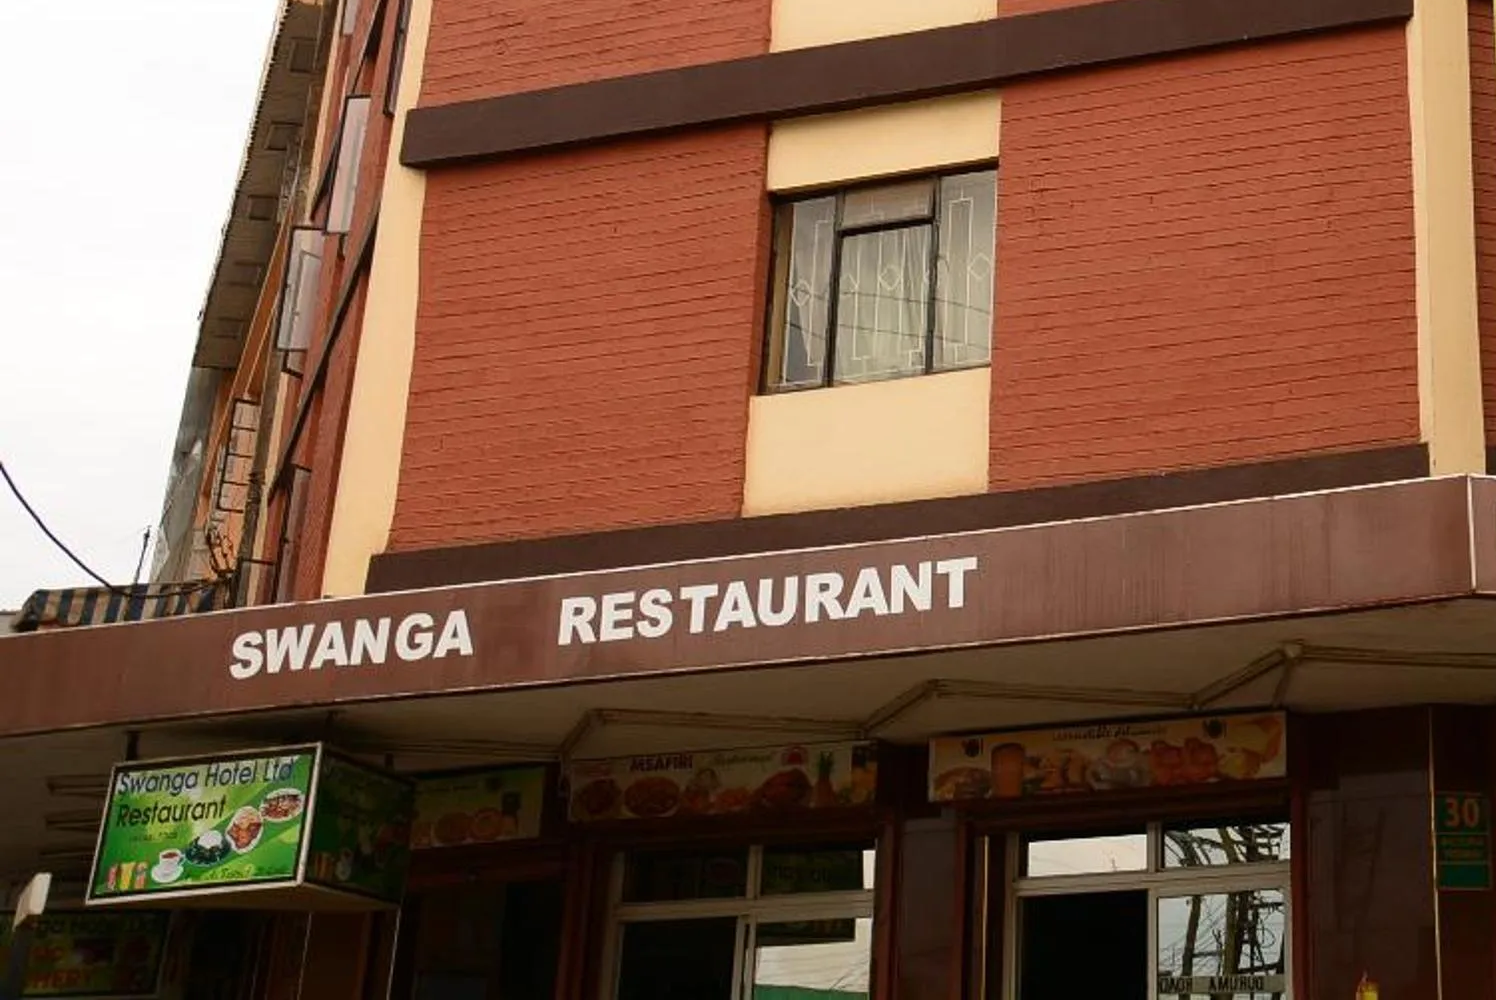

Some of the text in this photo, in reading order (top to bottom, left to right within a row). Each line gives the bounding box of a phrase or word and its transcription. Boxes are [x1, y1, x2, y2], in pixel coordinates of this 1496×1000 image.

[229, 556, 979, 680] SWANGA RESTAURANT
[117, 770, 198, 796] Swanga
[204, 762, 257, 788] Hotel
[263, 758, 296, 783] Ltd
[116, 796, 226, 828] Restaurant
[1444, 796, 1480, 829] 30
